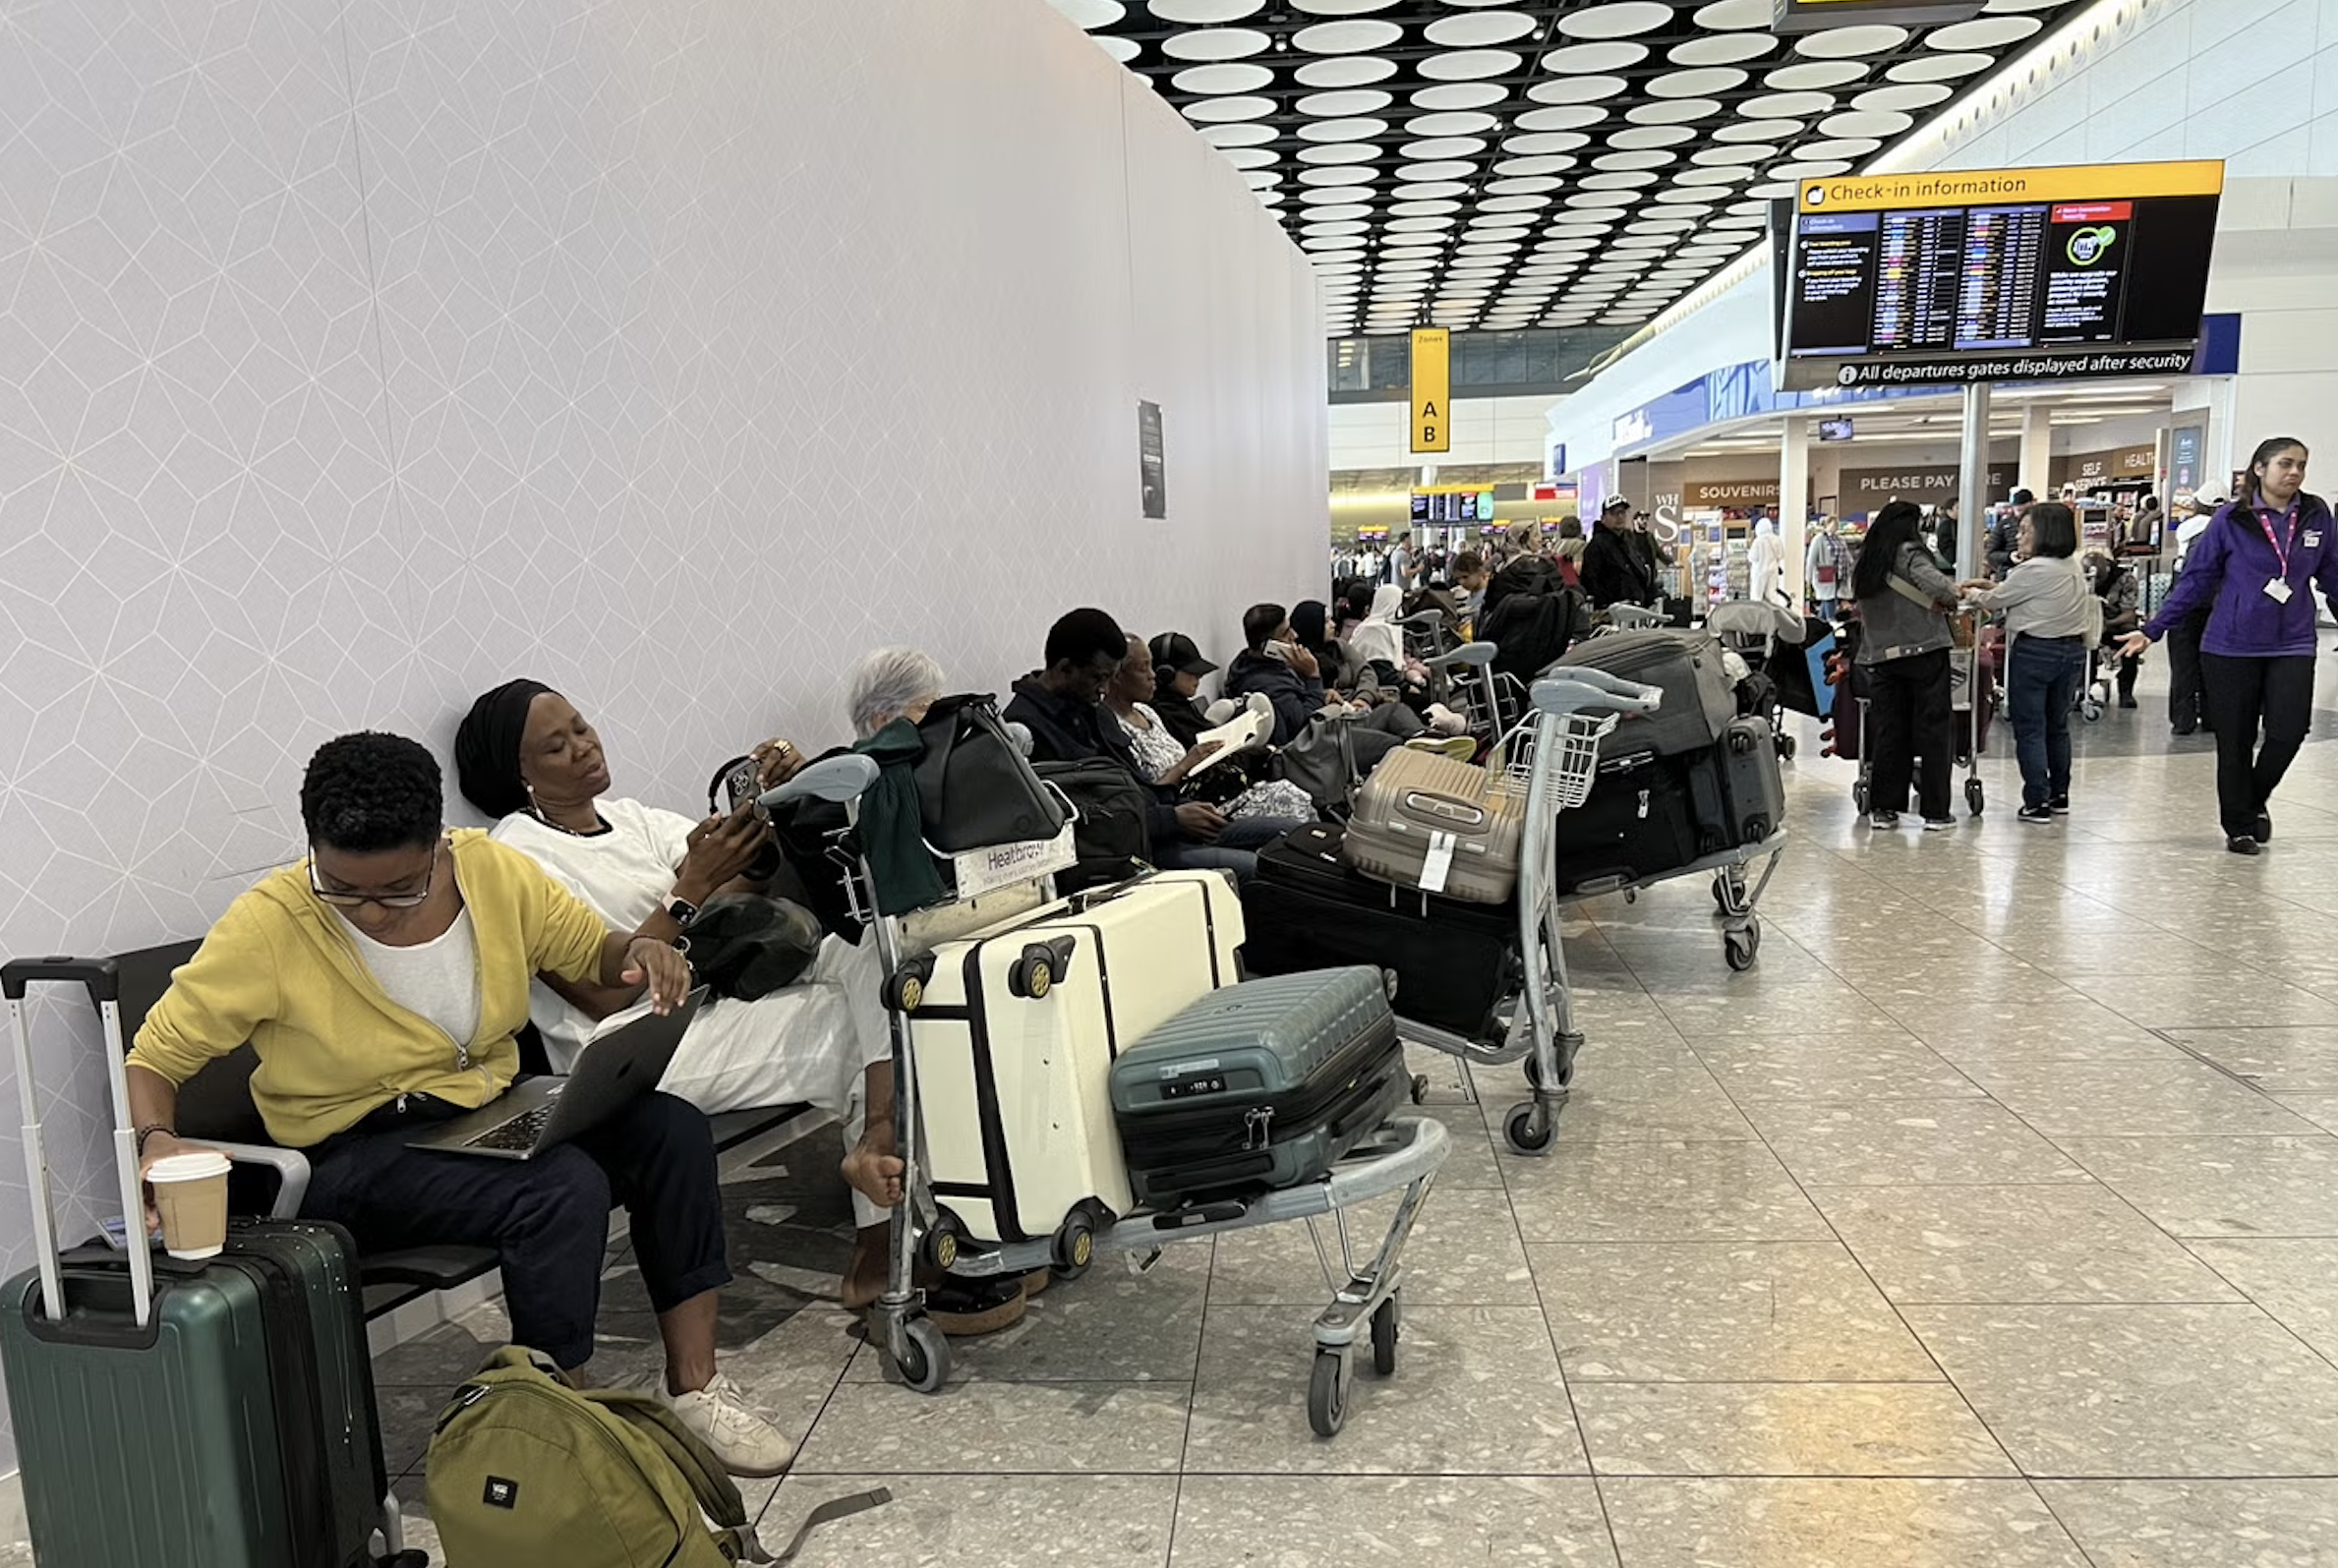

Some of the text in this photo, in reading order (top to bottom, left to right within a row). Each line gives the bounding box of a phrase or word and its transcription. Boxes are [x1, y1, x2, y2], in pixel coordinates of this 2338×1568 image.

[1830, 177, 2027, 201] Check-in information
[1858, 352, 2192, 383] All departures gates displayed after security
[1423, 401, 1437, 419] A
[1424, 426, 1436, 443] B
[2081, 461, 2103, 477] SELF
[1859, 476, 1921, 491] PLEASE
[1924, 474, 1956, 489] PAY
[1655, 494, 1680, 505] WH
[1654, 504, 1680, 543] S
